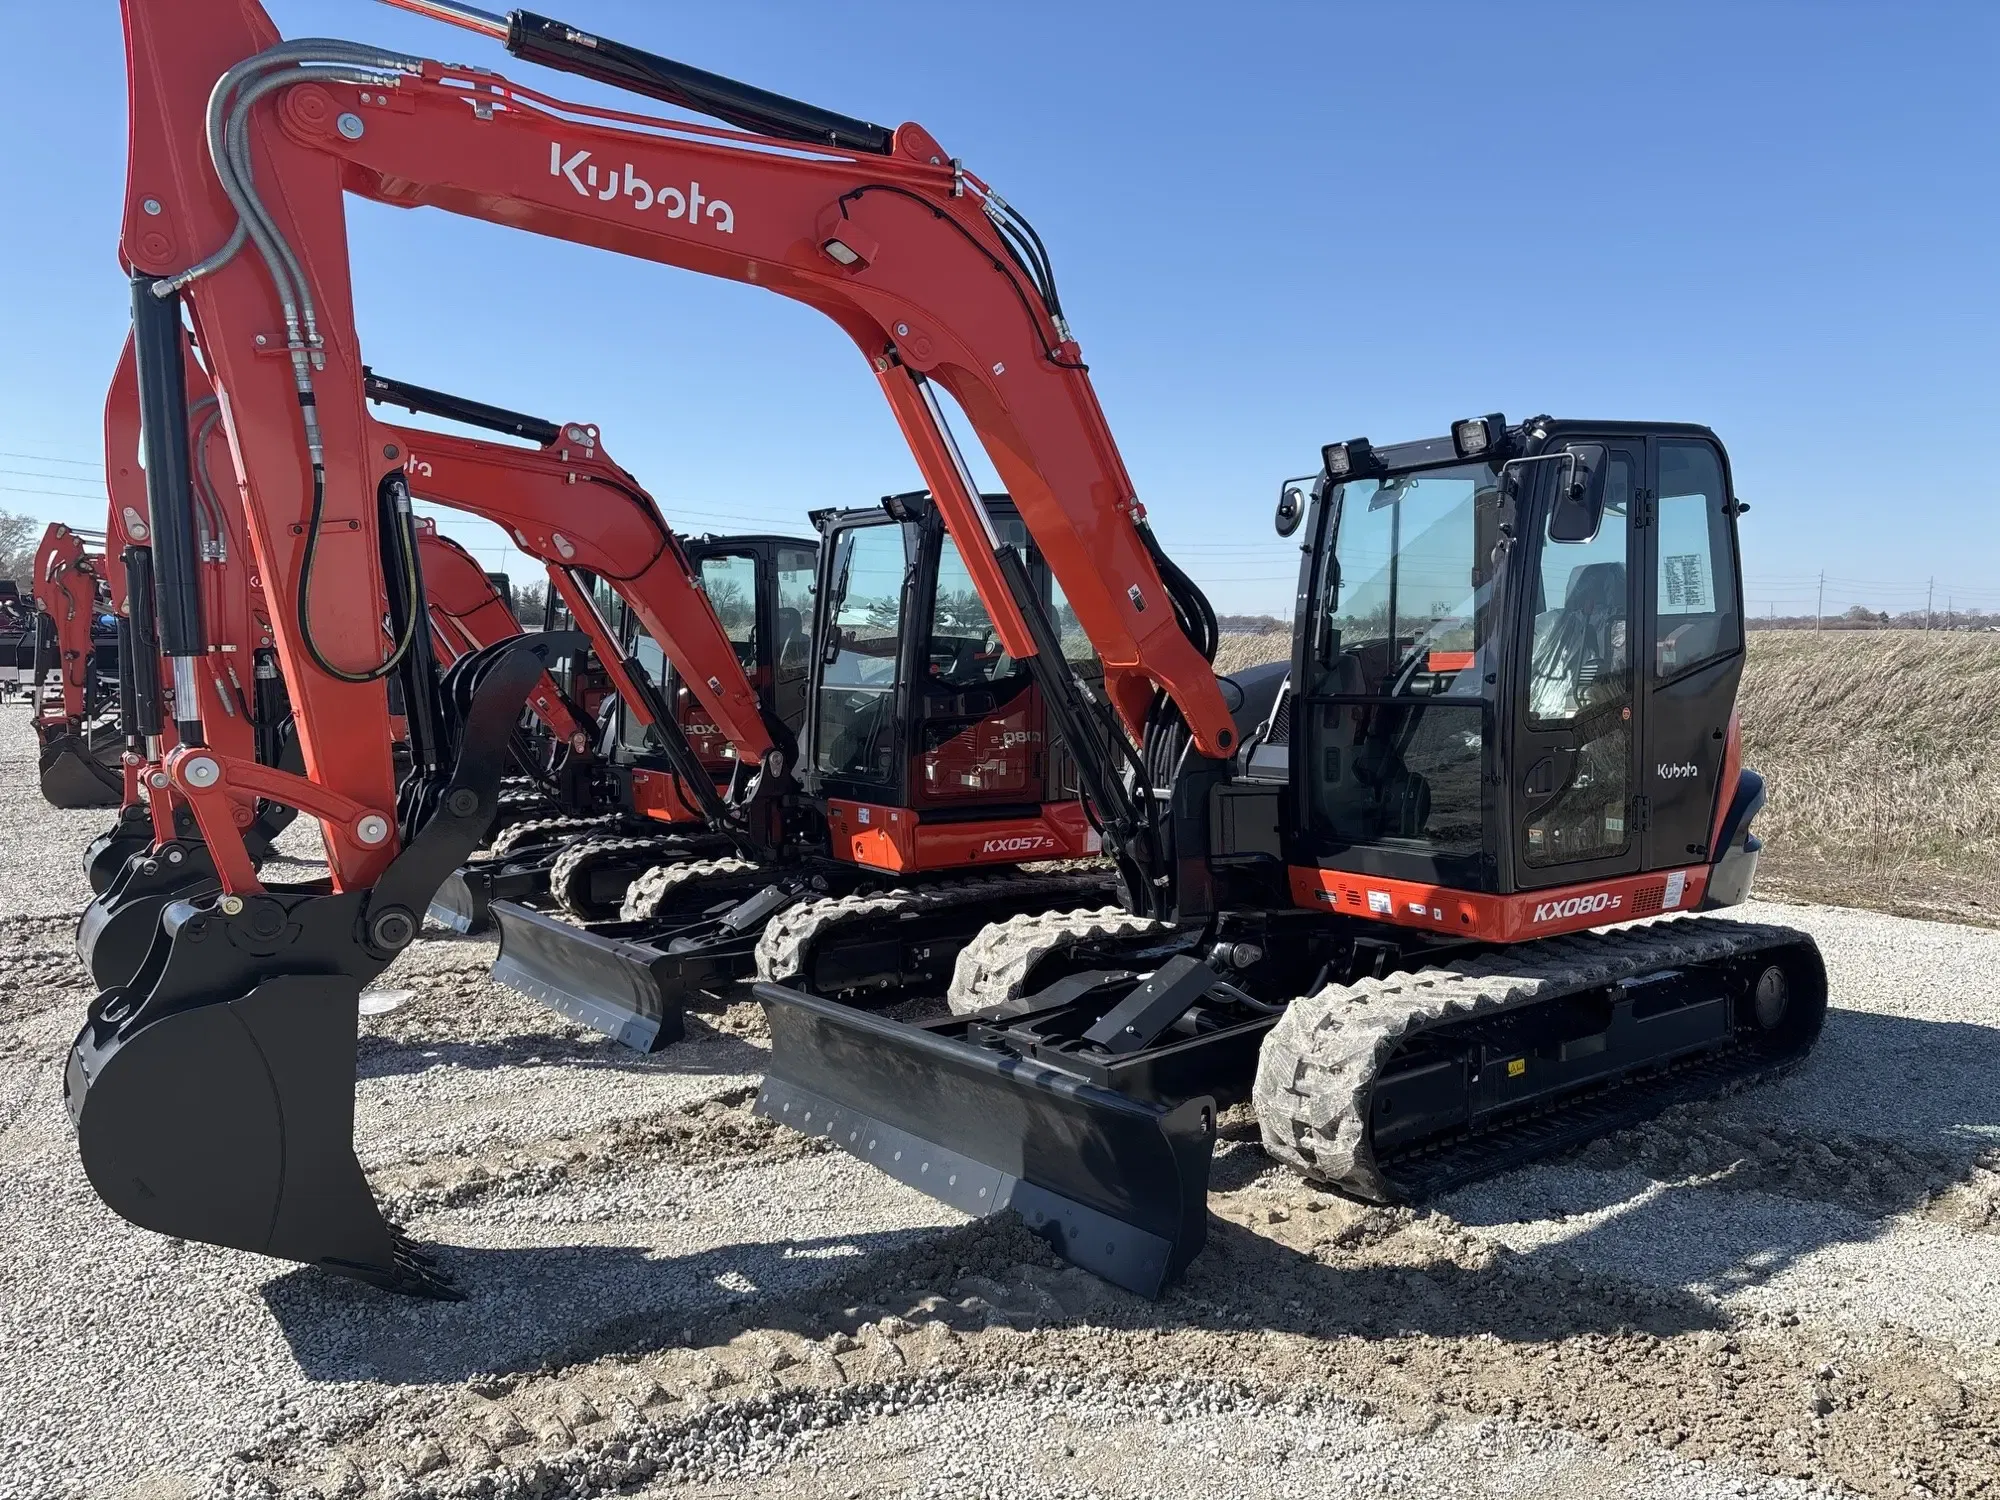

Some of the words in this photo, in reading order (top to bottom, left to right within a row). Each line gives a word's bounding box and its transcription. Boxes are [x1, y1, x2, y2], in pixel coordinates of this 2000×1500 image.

[550, 142, 734, 234] Kubota
[1657, 761, 1698, 779] Kubota
[982, 836, 1055, 853] KX057-5
[1532, 893, 1623, 923] KX080-5
